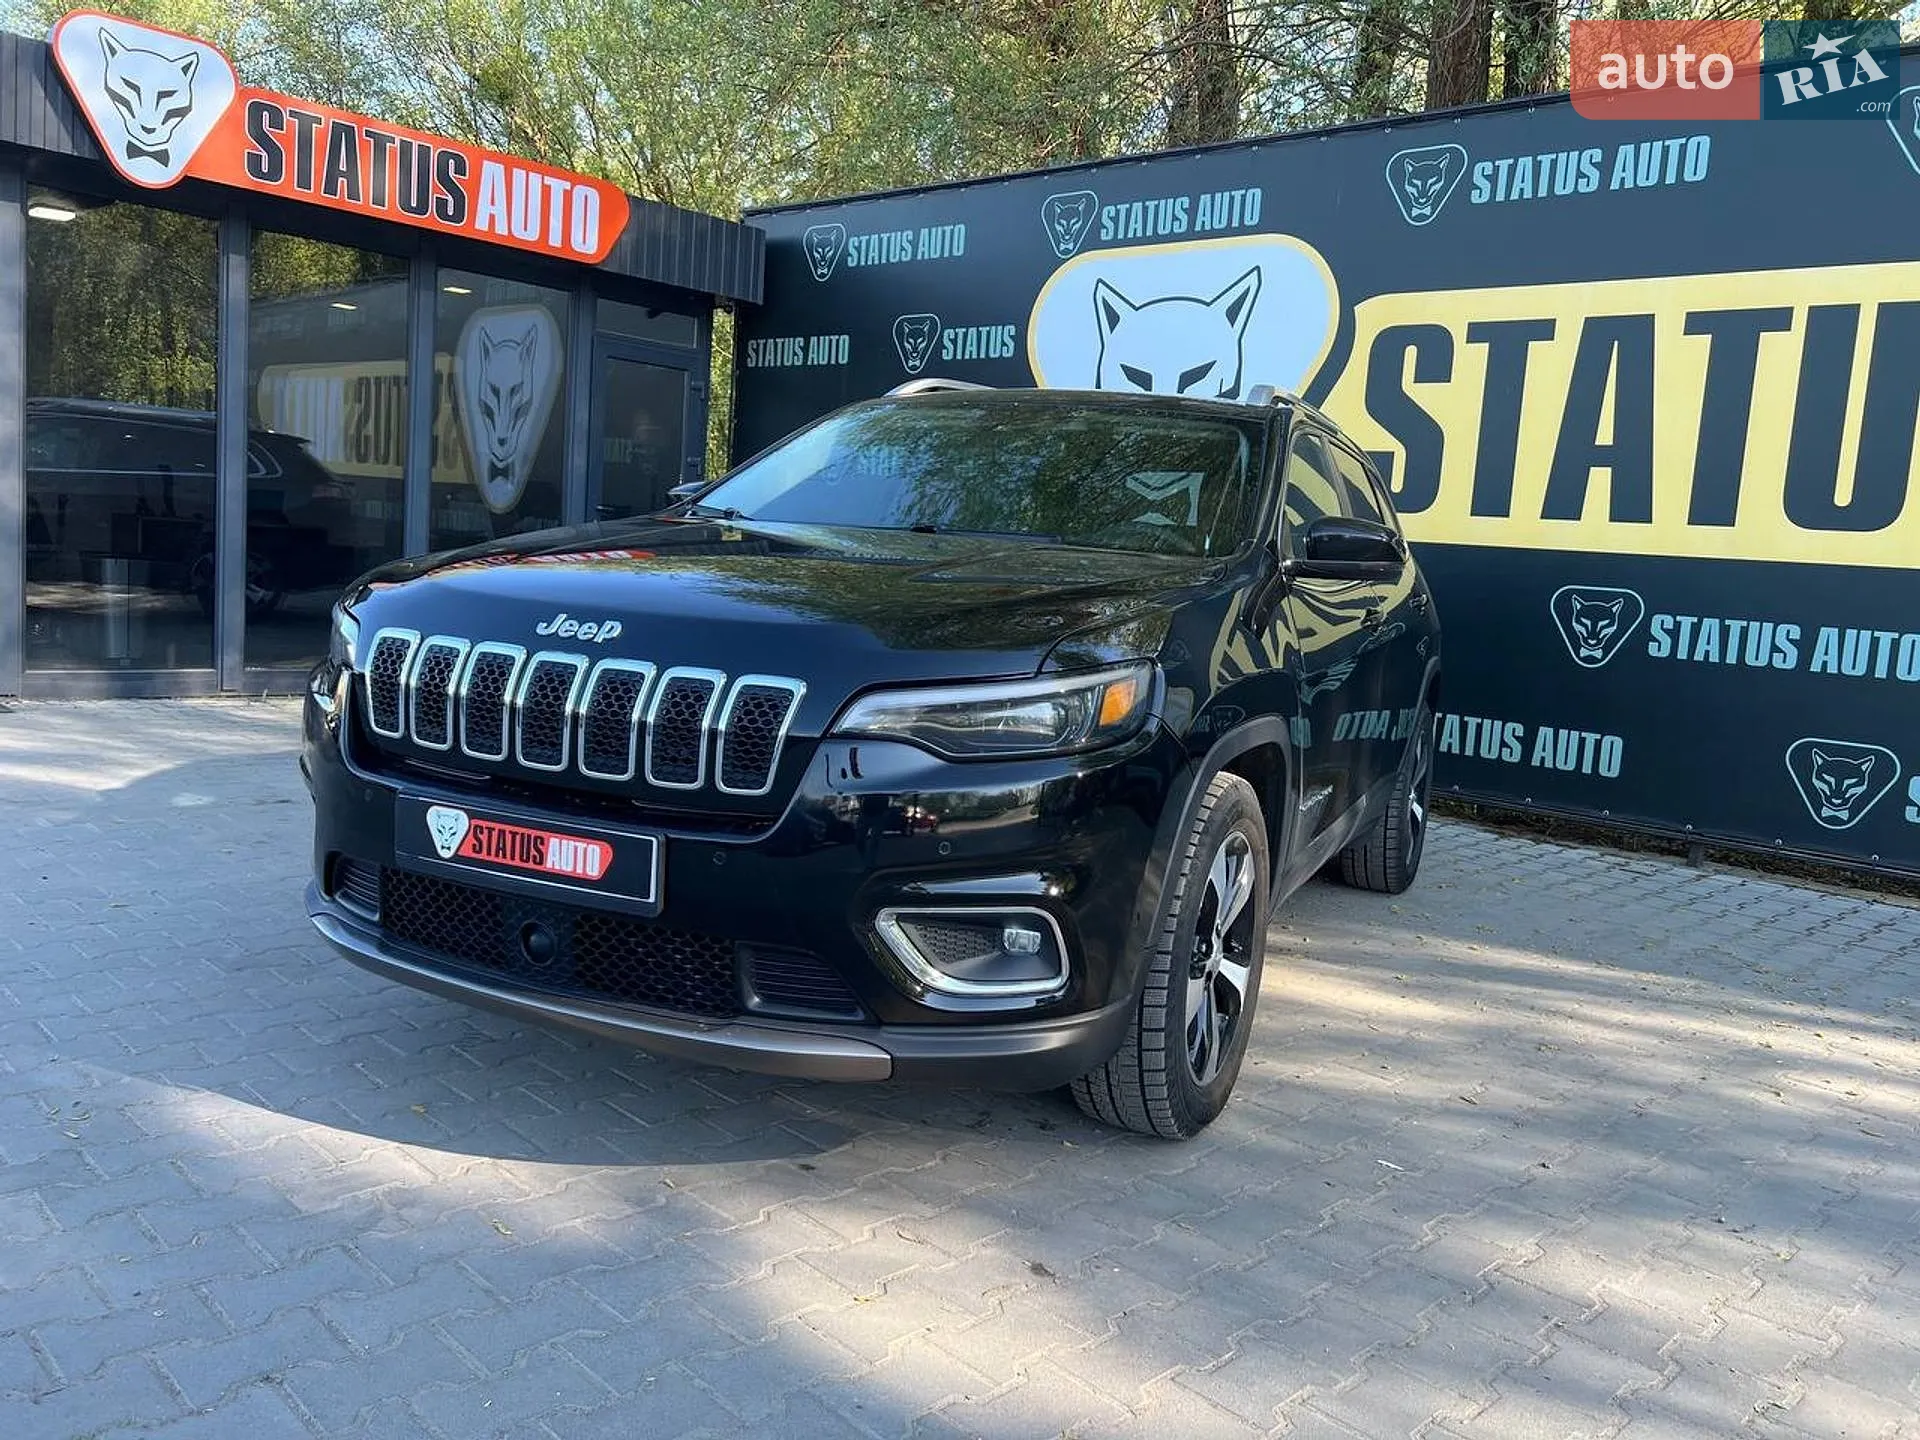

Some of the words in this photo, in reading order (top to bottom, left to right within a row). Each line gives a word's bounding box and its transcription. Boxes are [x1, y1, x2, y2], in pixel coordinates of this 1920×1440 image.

[244, 99, 469, 228] STATUS
[474, 160, 601, 256] AUTO
[1470, 148, 1602, 204] STATUS
[1608, 135, 1711, 191] AUTO
[1100, 195, 1189, 241] STATUS
[1194, 187, 1262, 232] AUTO
[847, 230, 914, 268] STATUS
[916, 224, 966, 261] AUTO
[747, 337, 805, 368] STATUS
[807, 334, 850, 366] AUTO
[942, 324, 1015, 361] STATUS
[535, 612, 623, 643] Jeep
[1648, 613, 1801, 670] STATUS
[1809, 626, 1920, 682] AUTO
[1531, 726, 1623, 779] AUTO
[471, 823, 545, 866] STATUS
[546, 836, 600, 877] AUTO
